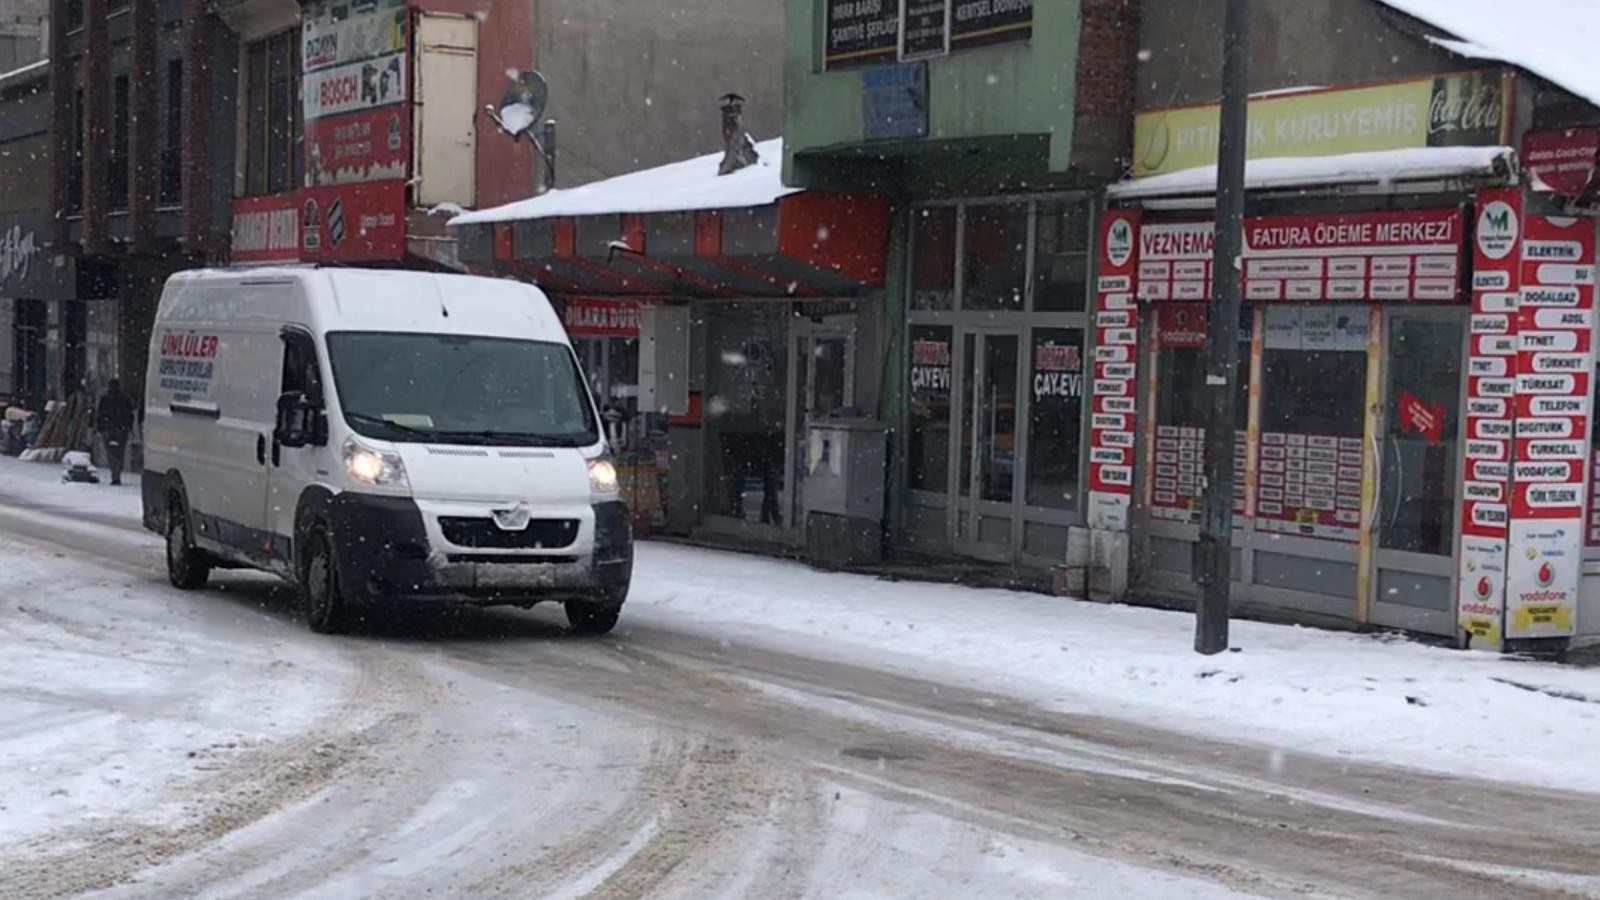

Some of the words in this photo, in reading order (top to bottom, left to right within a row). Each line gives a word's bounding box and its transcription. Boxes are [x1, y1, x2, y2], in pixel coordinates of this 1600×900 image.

[320, 74, 358, 107] BOSCH
[1252, 227, 1312, 246] FATURA
[1314, 221, 1372, 244] ÖDEME
[1376, 215, 1453, 242] MERKEZİ
[1527, 244, 1575, 257] ELEKTRİK
[1575, 269, 1588, 280] SU
[1525, 287, 1576, 303] DOĞALGAZ
[1561, 313, 1585, 324] ADSL
[160, 329, 219, 359] ÜNLÜLER
[1523, 335, 1555, 346] TTNET
[1539, 357, 1582, 369] TÜRKNET
[1521, 378, 1565, 390] TÜRKSAT
[1539, 400, 1581, 411] TELEFON
[1517, 466, 1567, 477] VODAFONE
[1519, 590, 1567, 602] vodafone
